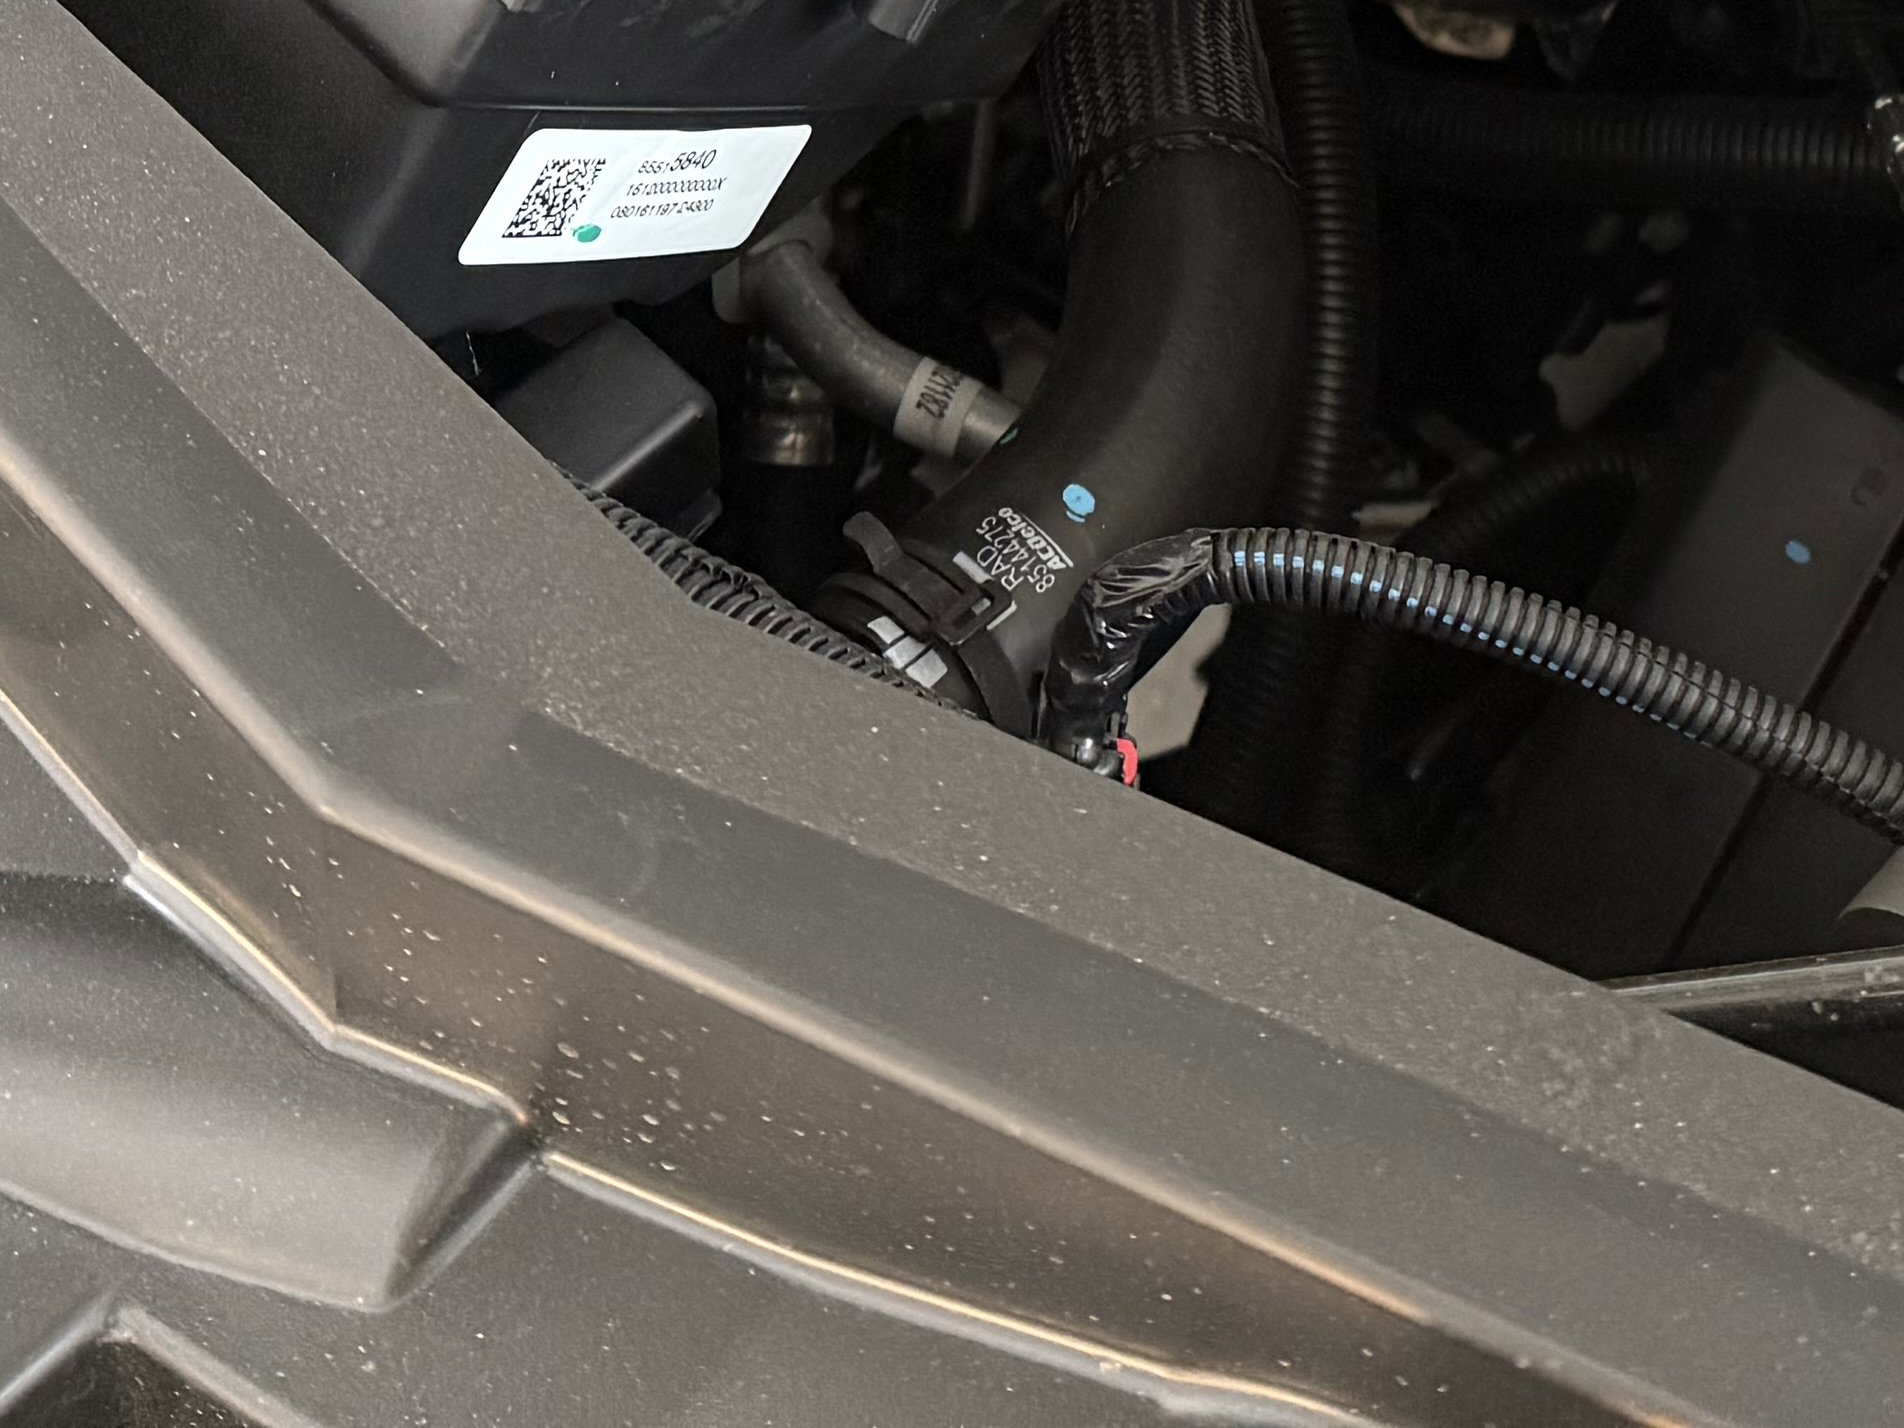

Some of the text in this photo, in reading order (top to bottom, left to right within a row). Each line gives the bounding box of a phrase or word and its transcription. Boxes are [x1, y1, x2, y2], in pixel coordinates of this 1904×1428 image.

[976, 516, 1056, 593] 85144275
[977, 545, 1025, 592] RAD
[998, 507, 1067, 570] ACDelco
